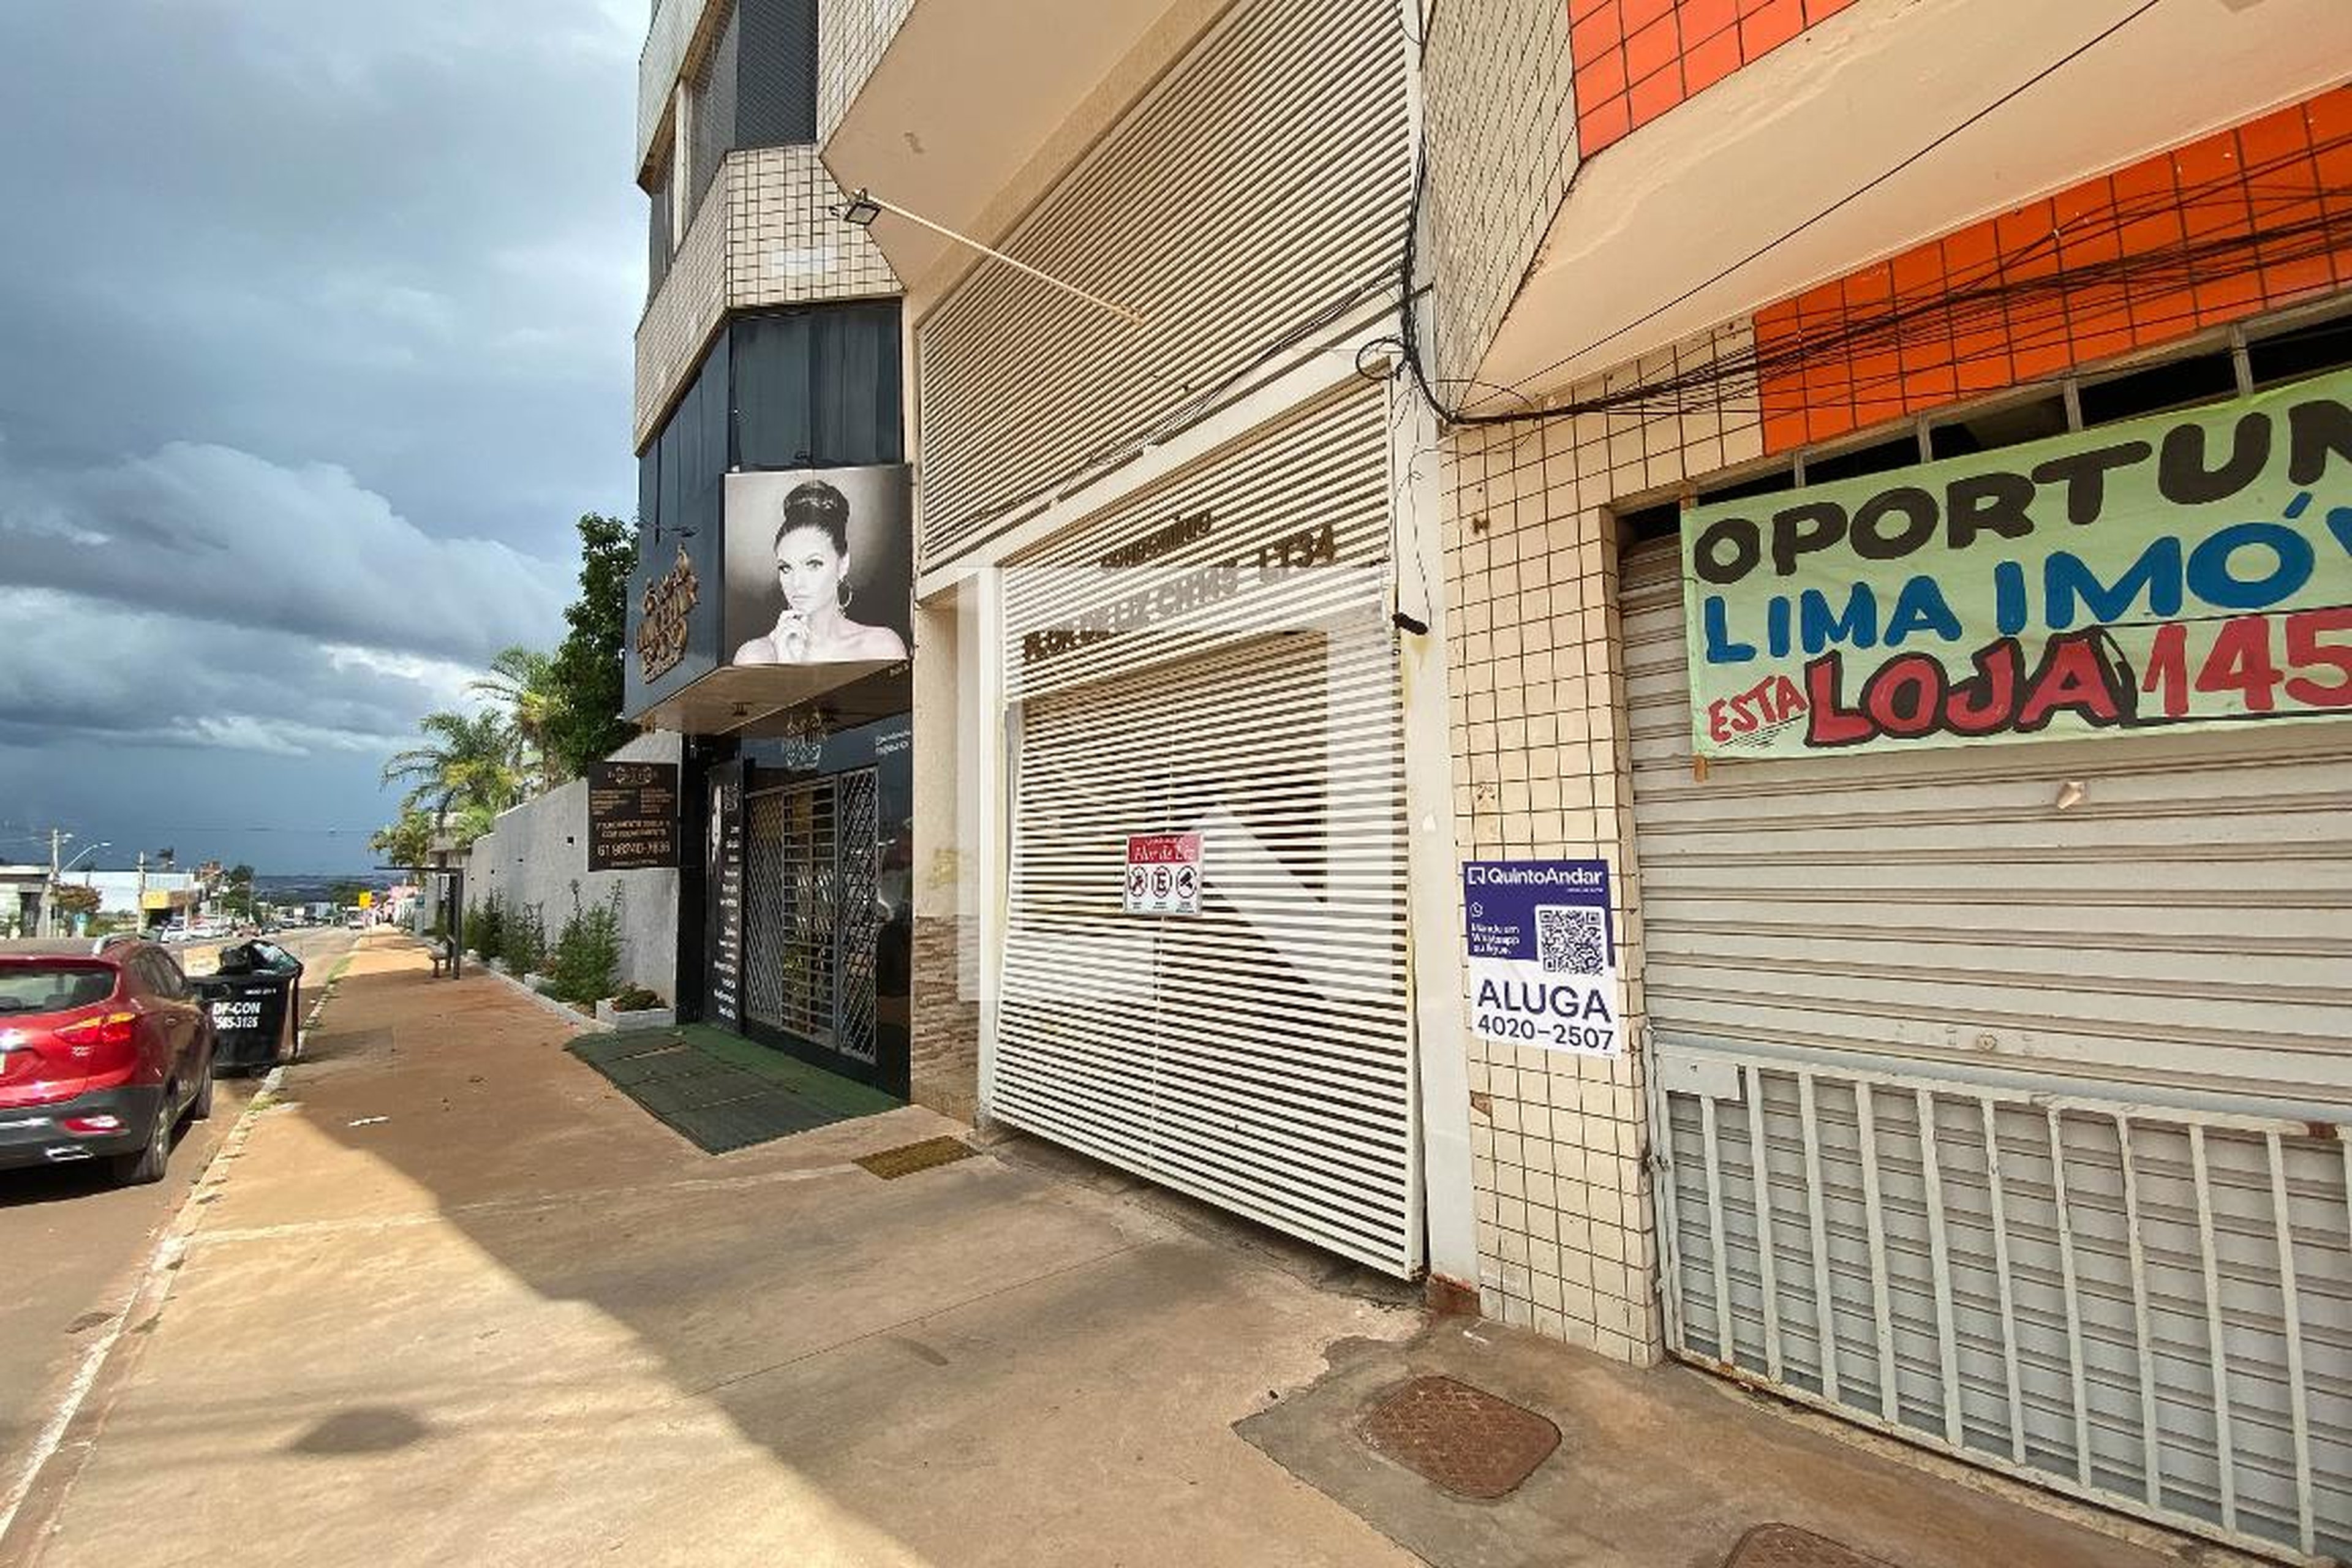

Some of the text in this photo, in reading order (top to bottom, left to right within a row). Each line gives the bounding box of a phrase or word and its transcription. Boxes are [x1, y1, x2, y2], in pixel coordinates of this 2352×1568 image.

[1694, 399, 2352, 584] OPORTUN
[1704, 575, 1962, 664] LIMA
[1707, 607, 2352, 747] ESTA LOJA 145
[1488, 868, 1604, 884] QuintoAndar
[1477, 979, 1611, 1023] ALUGA
[1478, 1014, 1613, 1050] 4020-2507
